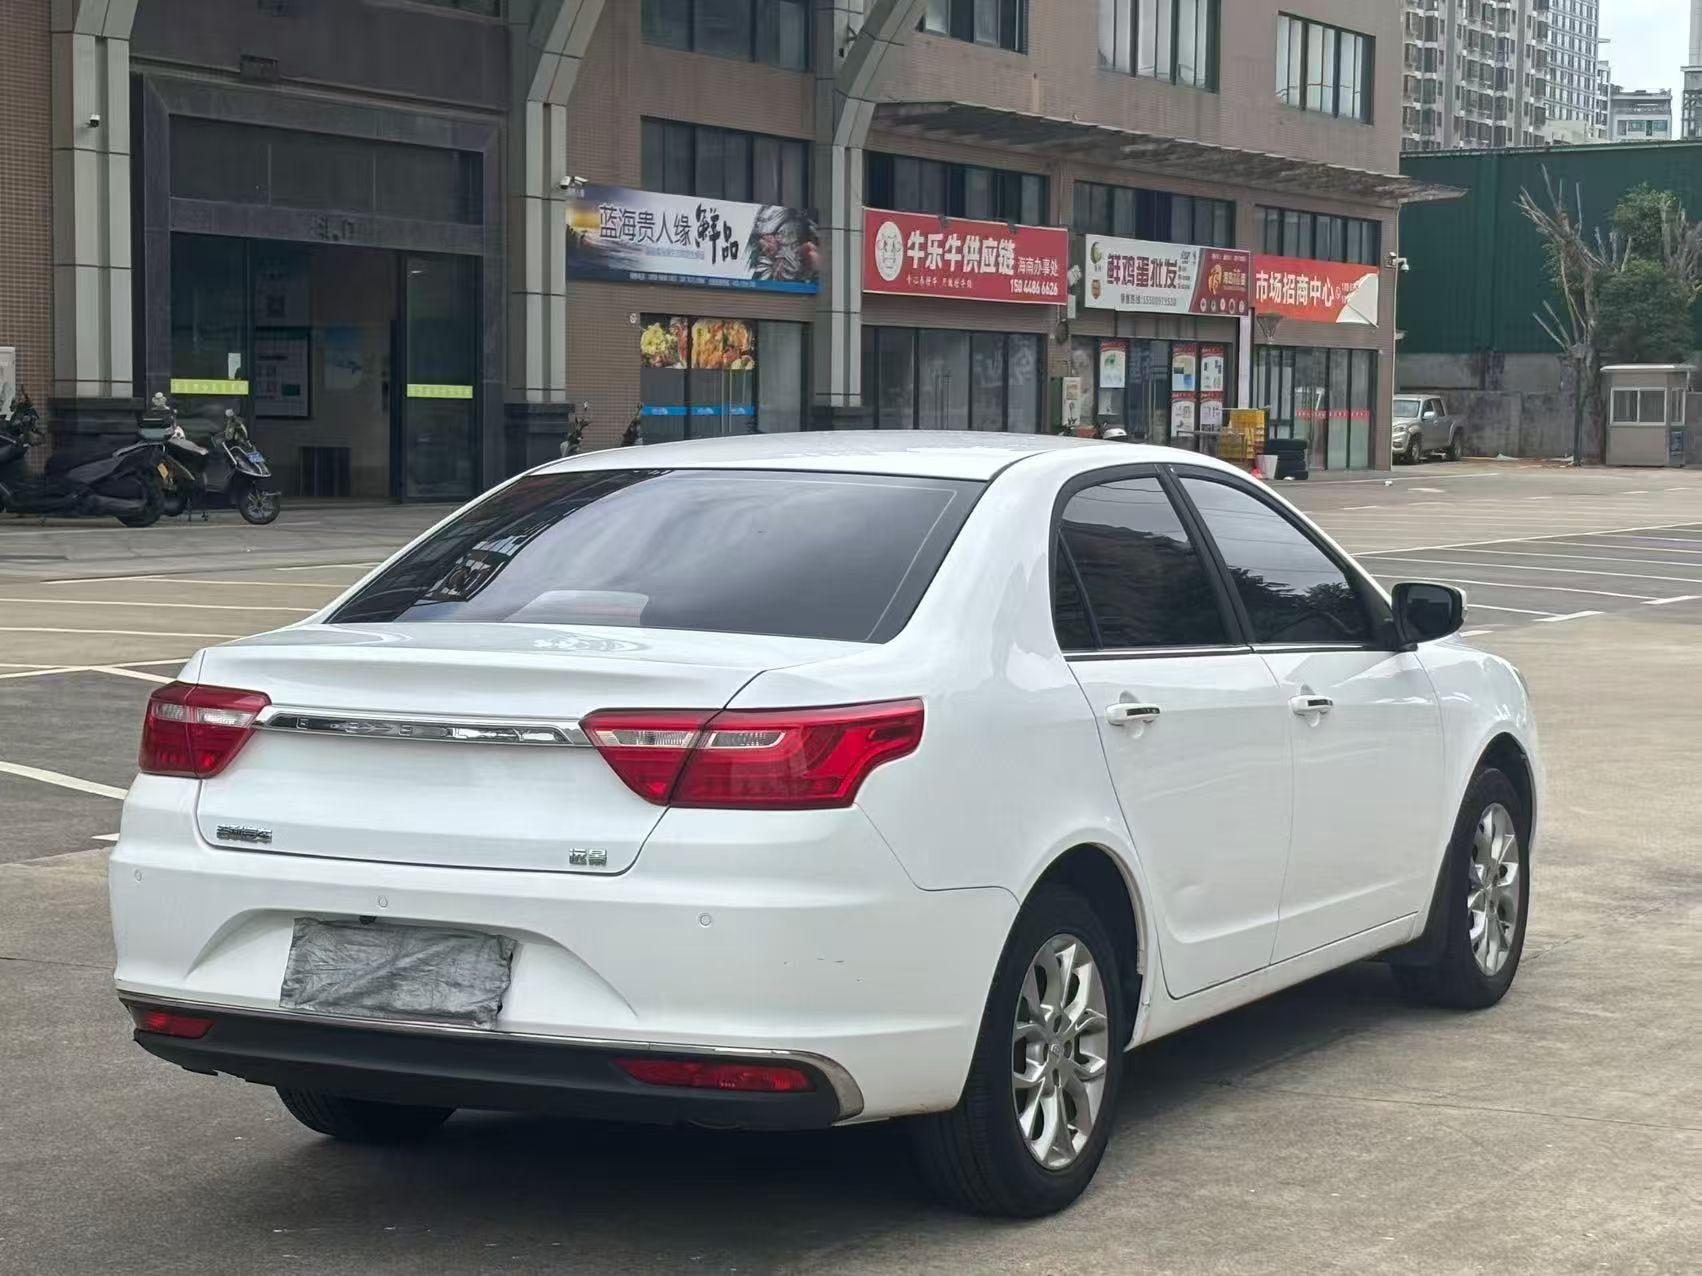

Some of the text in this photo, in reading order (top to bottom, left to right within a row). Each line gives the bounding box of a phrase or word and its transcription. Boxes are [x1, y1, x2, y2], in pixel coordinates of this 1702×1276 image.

[599, 203, 739, 265] 蓝海贵人缘 鲜品
[906, 230, 1016, 275] 牛乐牛供应链
[1016, 256, 1059, 277] 海南办事处
[1107, 252, 1178, 289] 鲜鸡蛋批发
[1256, 270, 1334, 307] 市场招商中心
